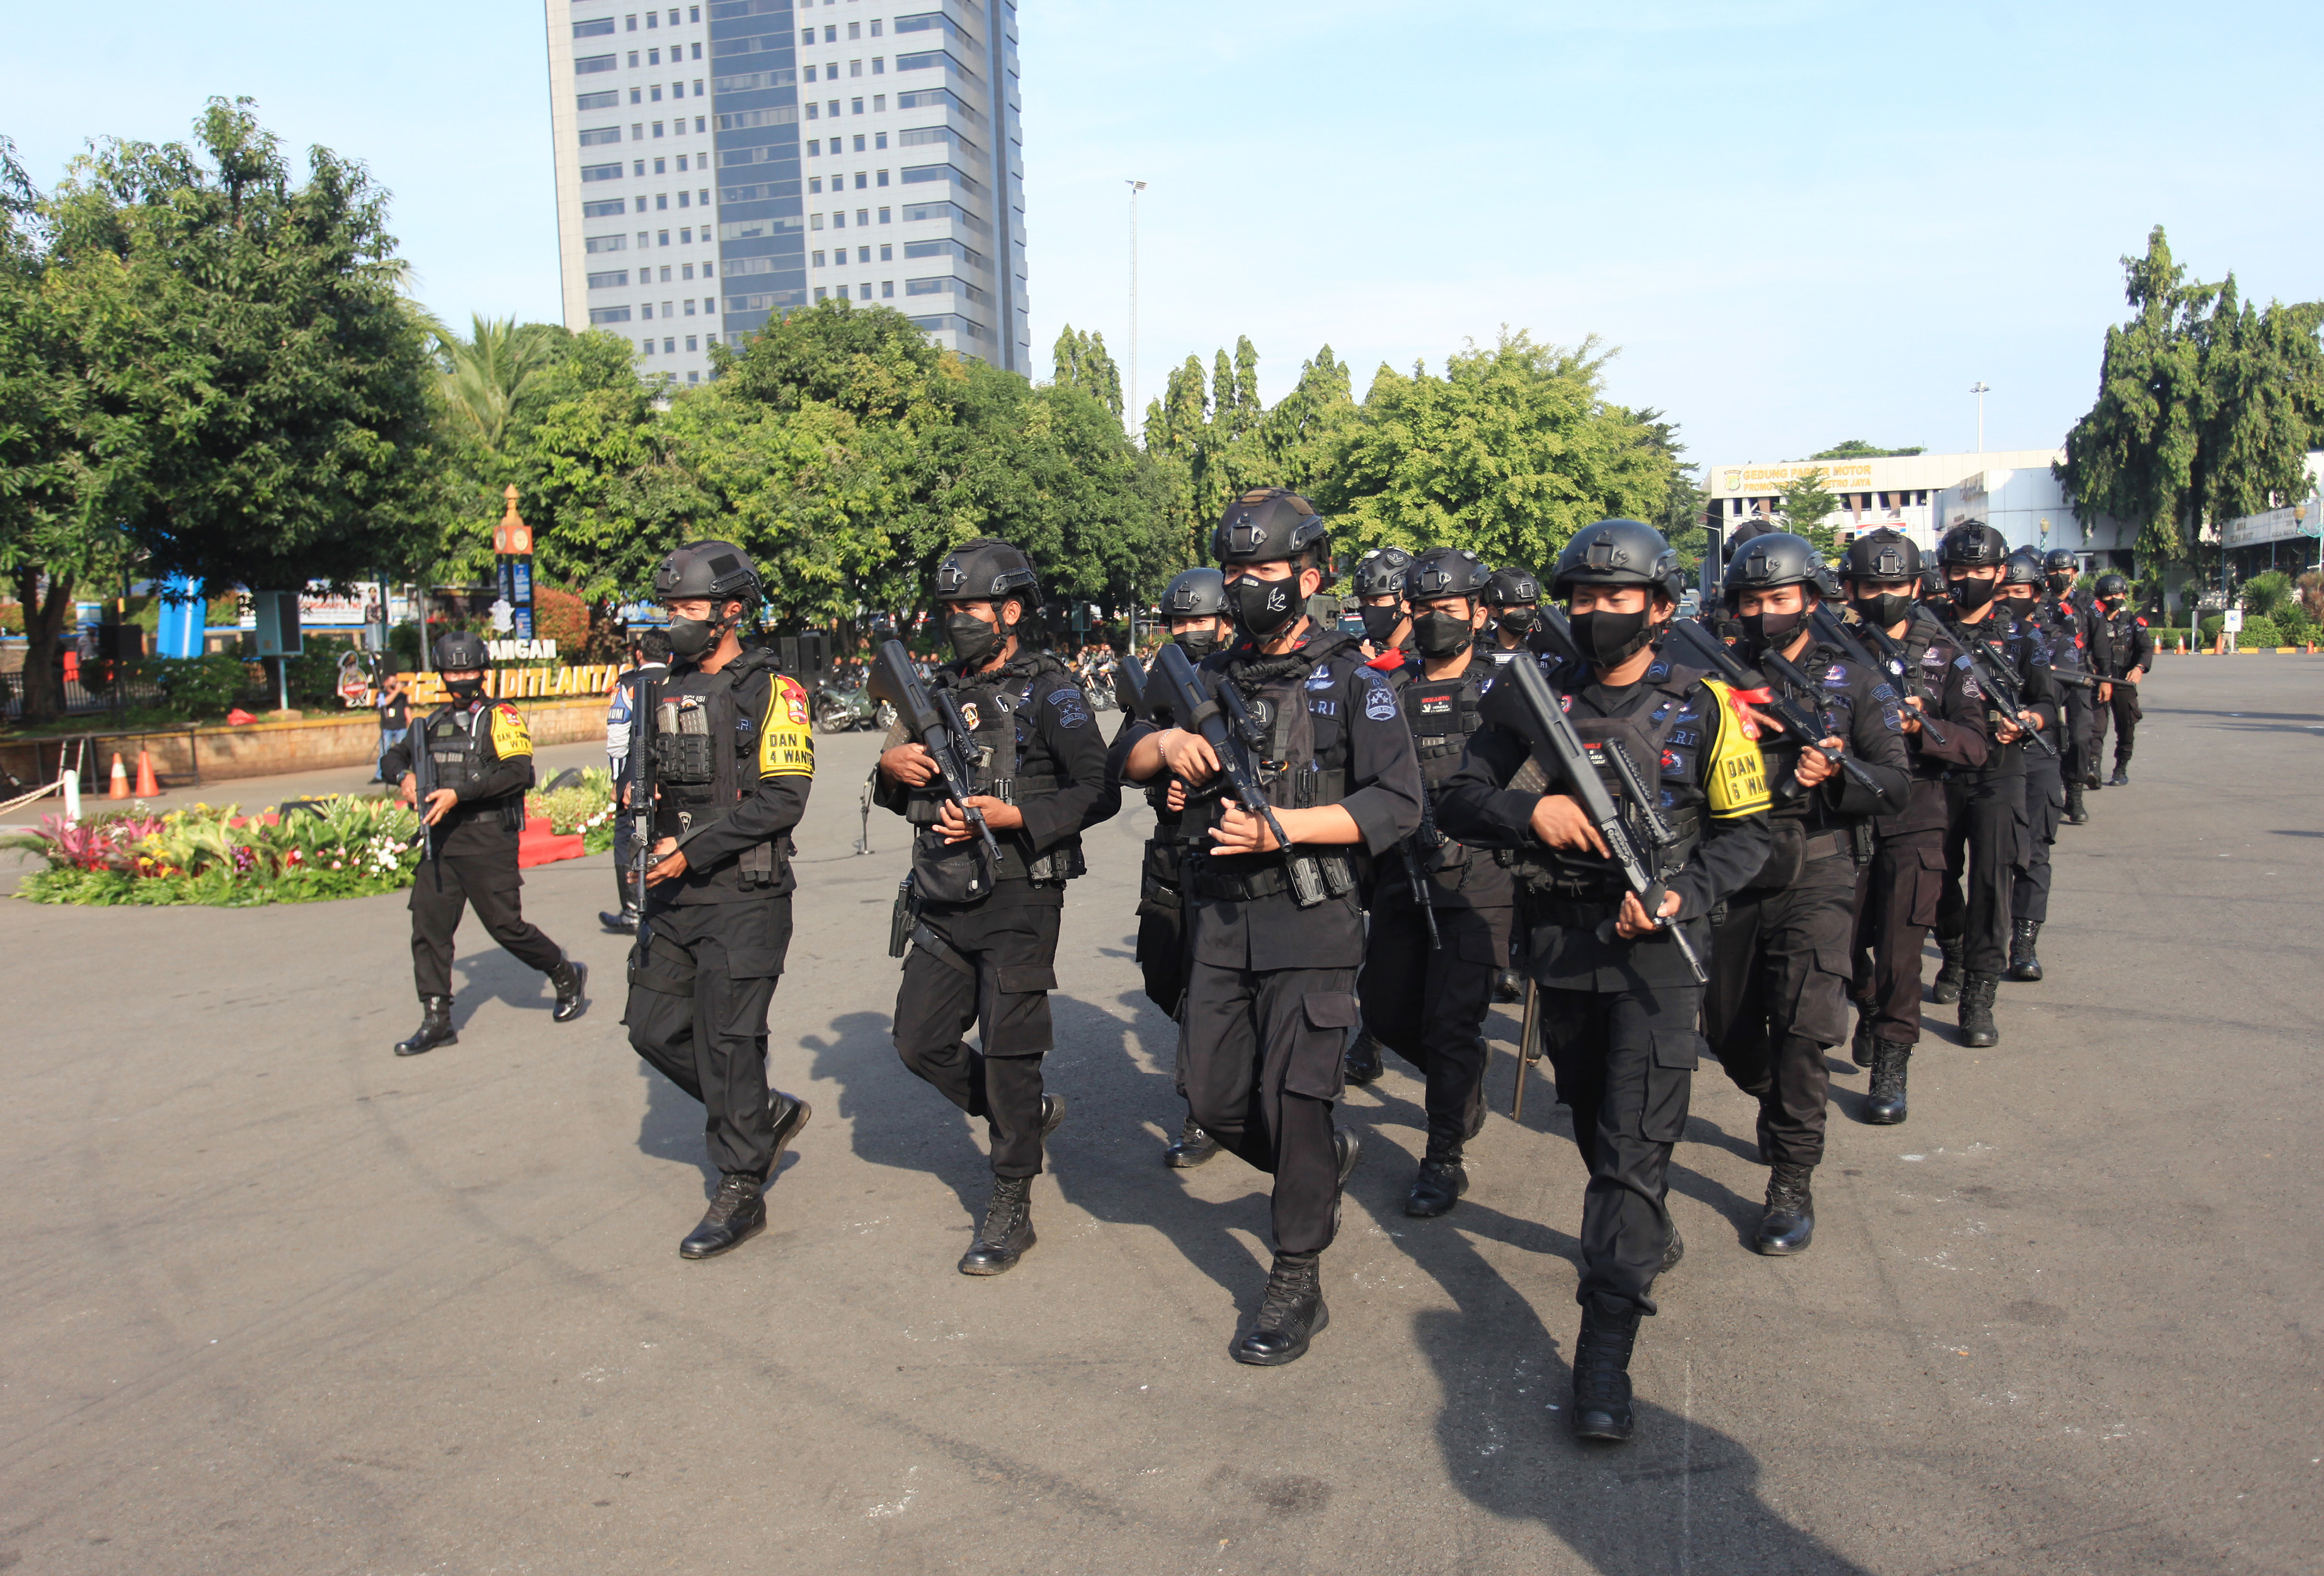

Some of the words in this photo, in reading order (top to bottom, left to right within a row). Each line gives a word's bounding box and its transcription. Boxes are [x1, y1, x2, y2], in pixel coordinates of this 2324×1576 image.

[1744, 469, 1788, 480] GEDUNG
[1791, 467, 1830, 478] PARIR
[1834, 465, 1871, 476] MOTOR
[1850, 478, 1871, 488] JAYA
[487, 639, 557, 660] ANGAN
[1308, 700, 1335, 715] LRI
[497, 732, 511, 742] DAN
[770, 734, 797, 747] DAN
[770, 751, 777, 764] 4
[1726, 754, 1756, 779] DAN
[1731, 782, 1741, 800] 6
[1744, 775, 1768, 797] WA
